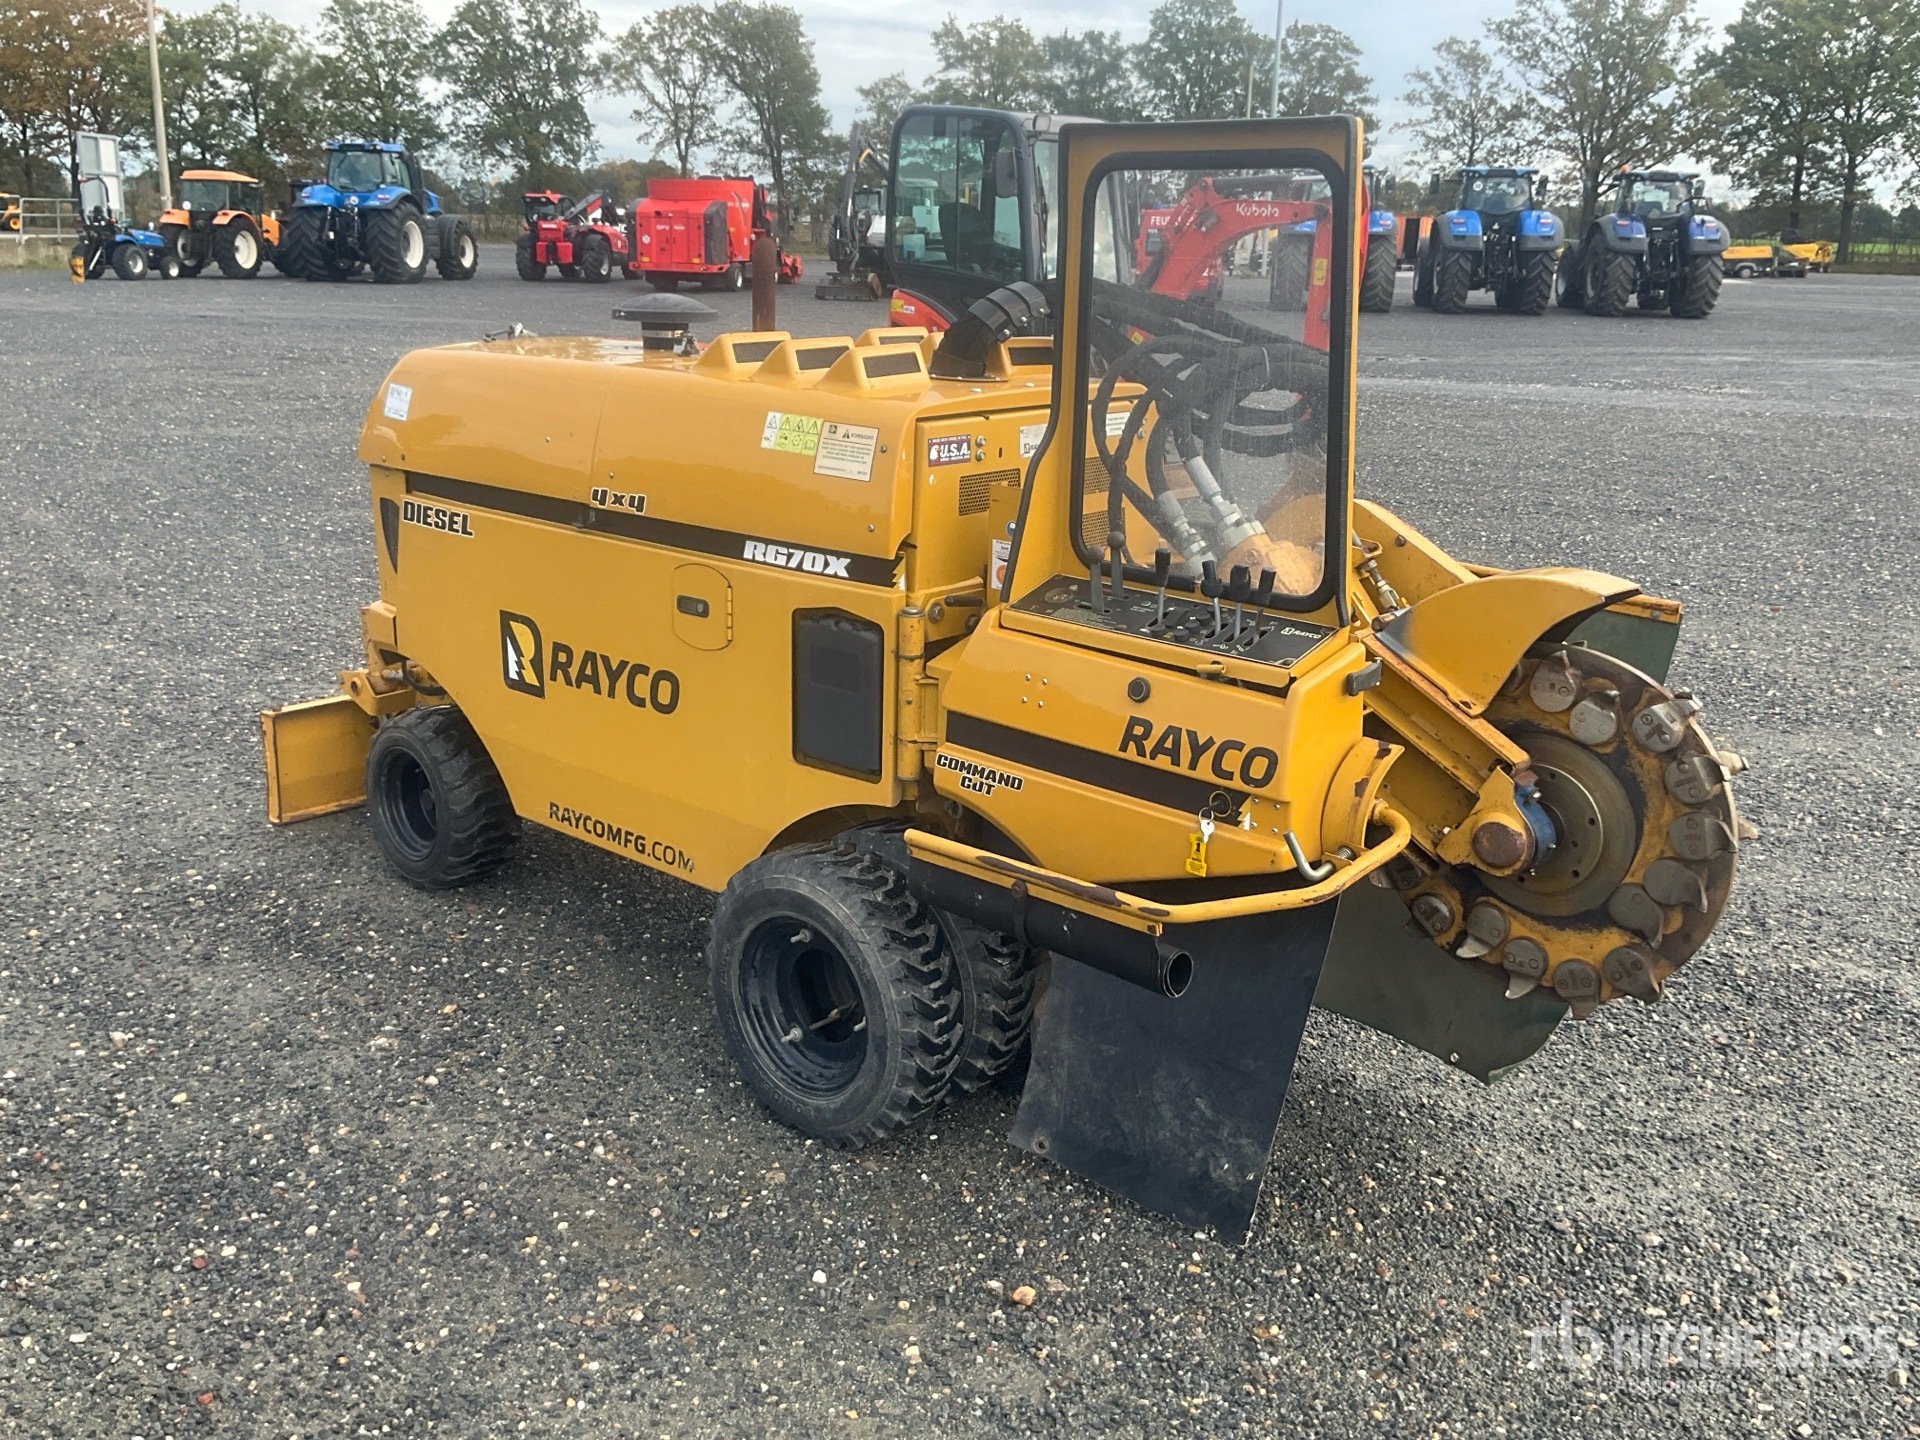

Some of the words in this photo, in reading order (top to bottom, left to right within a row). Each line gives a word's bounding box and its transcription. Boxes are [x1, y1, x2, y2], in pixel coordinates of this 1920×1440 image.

[1236, 203, 1280, 217] Kubota
[940, 442, 971, 457] U.S.A.
[402, 499, 475, 538] DIESEL
[743, 540, 851, 579] RG70X
[1292, 629, 1323, 640] RAYCO
[549, 641, 681, 715] RAYCO
[1118, 715, 1279, 788] RAYCO
[935, 752, 1024, 792] COMMAND
[959, 775, 996, 797] CUT
[548, 800, 695, 873] RAYCOMFG.COM
